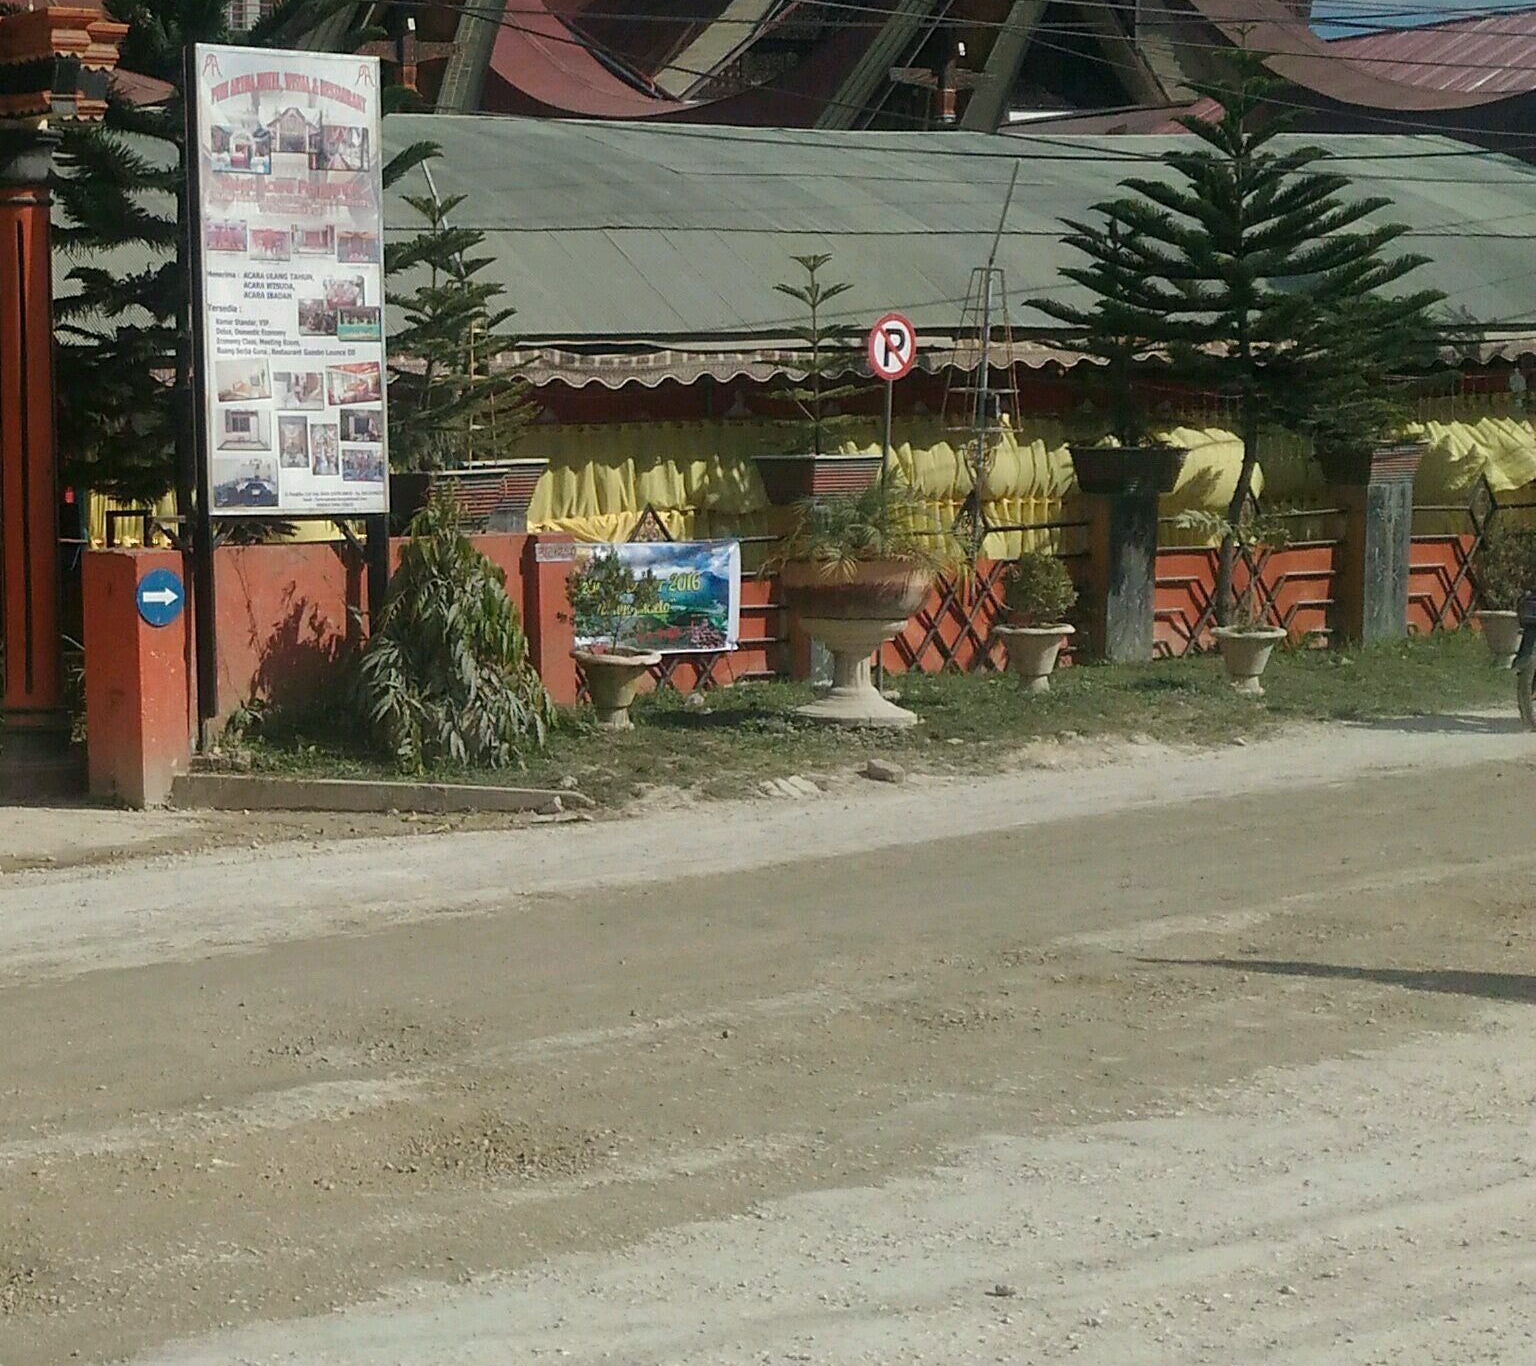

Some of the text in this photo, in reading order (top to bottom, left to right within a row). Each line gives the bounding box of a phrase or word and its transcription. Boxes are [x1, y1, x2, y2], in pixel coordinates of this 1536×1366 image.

[243, 271, 265, 280] ACARA
[243, 281, 265, 290] ACARA
[243, 291, 265, 300] ACARA
[668, 573, 701, 592] 2016
